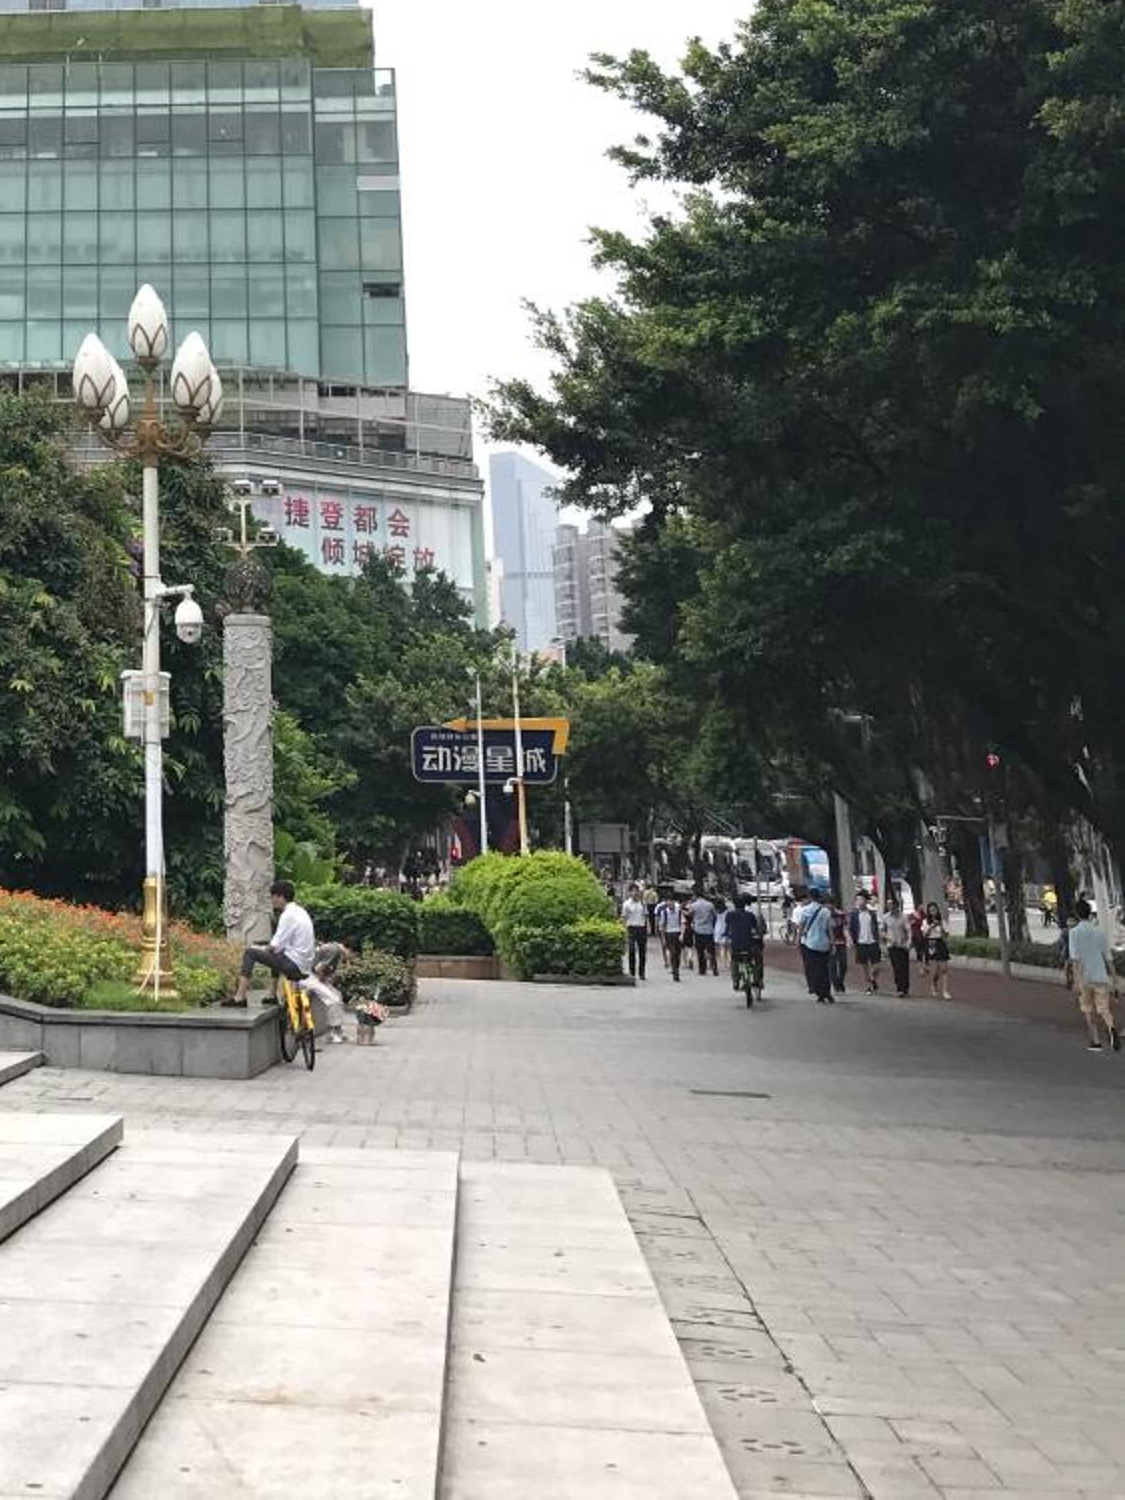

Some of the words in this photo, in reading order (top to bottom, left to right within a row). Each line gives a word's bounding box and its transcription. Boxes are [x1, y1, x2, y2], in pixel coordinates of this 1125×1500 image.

[284, 496, 411, 538] 捷登都会
[423, 746, 546, 773] 动漫星城
